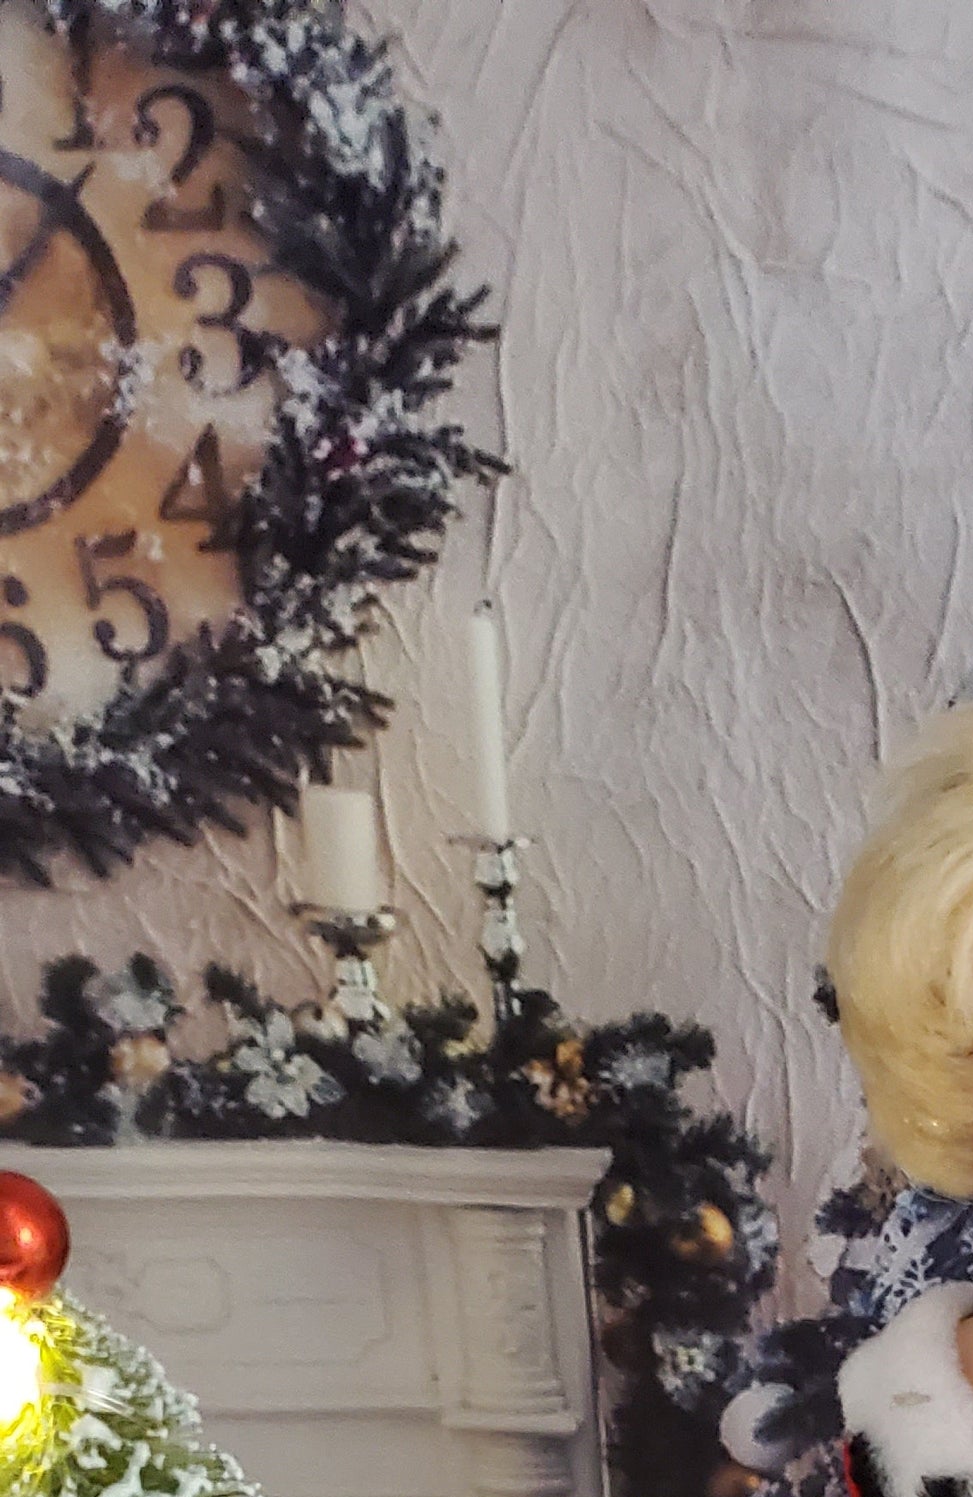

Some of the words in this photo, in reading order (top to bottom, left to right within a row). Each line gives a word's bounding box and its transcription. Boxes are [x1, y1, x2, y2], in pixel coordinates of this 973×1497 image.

[133, 84, 224, 231] 2
[174, 253, 256, 397] 3
[159, 423, 250, 553] 4
[75, 528, 168, 663] 5
